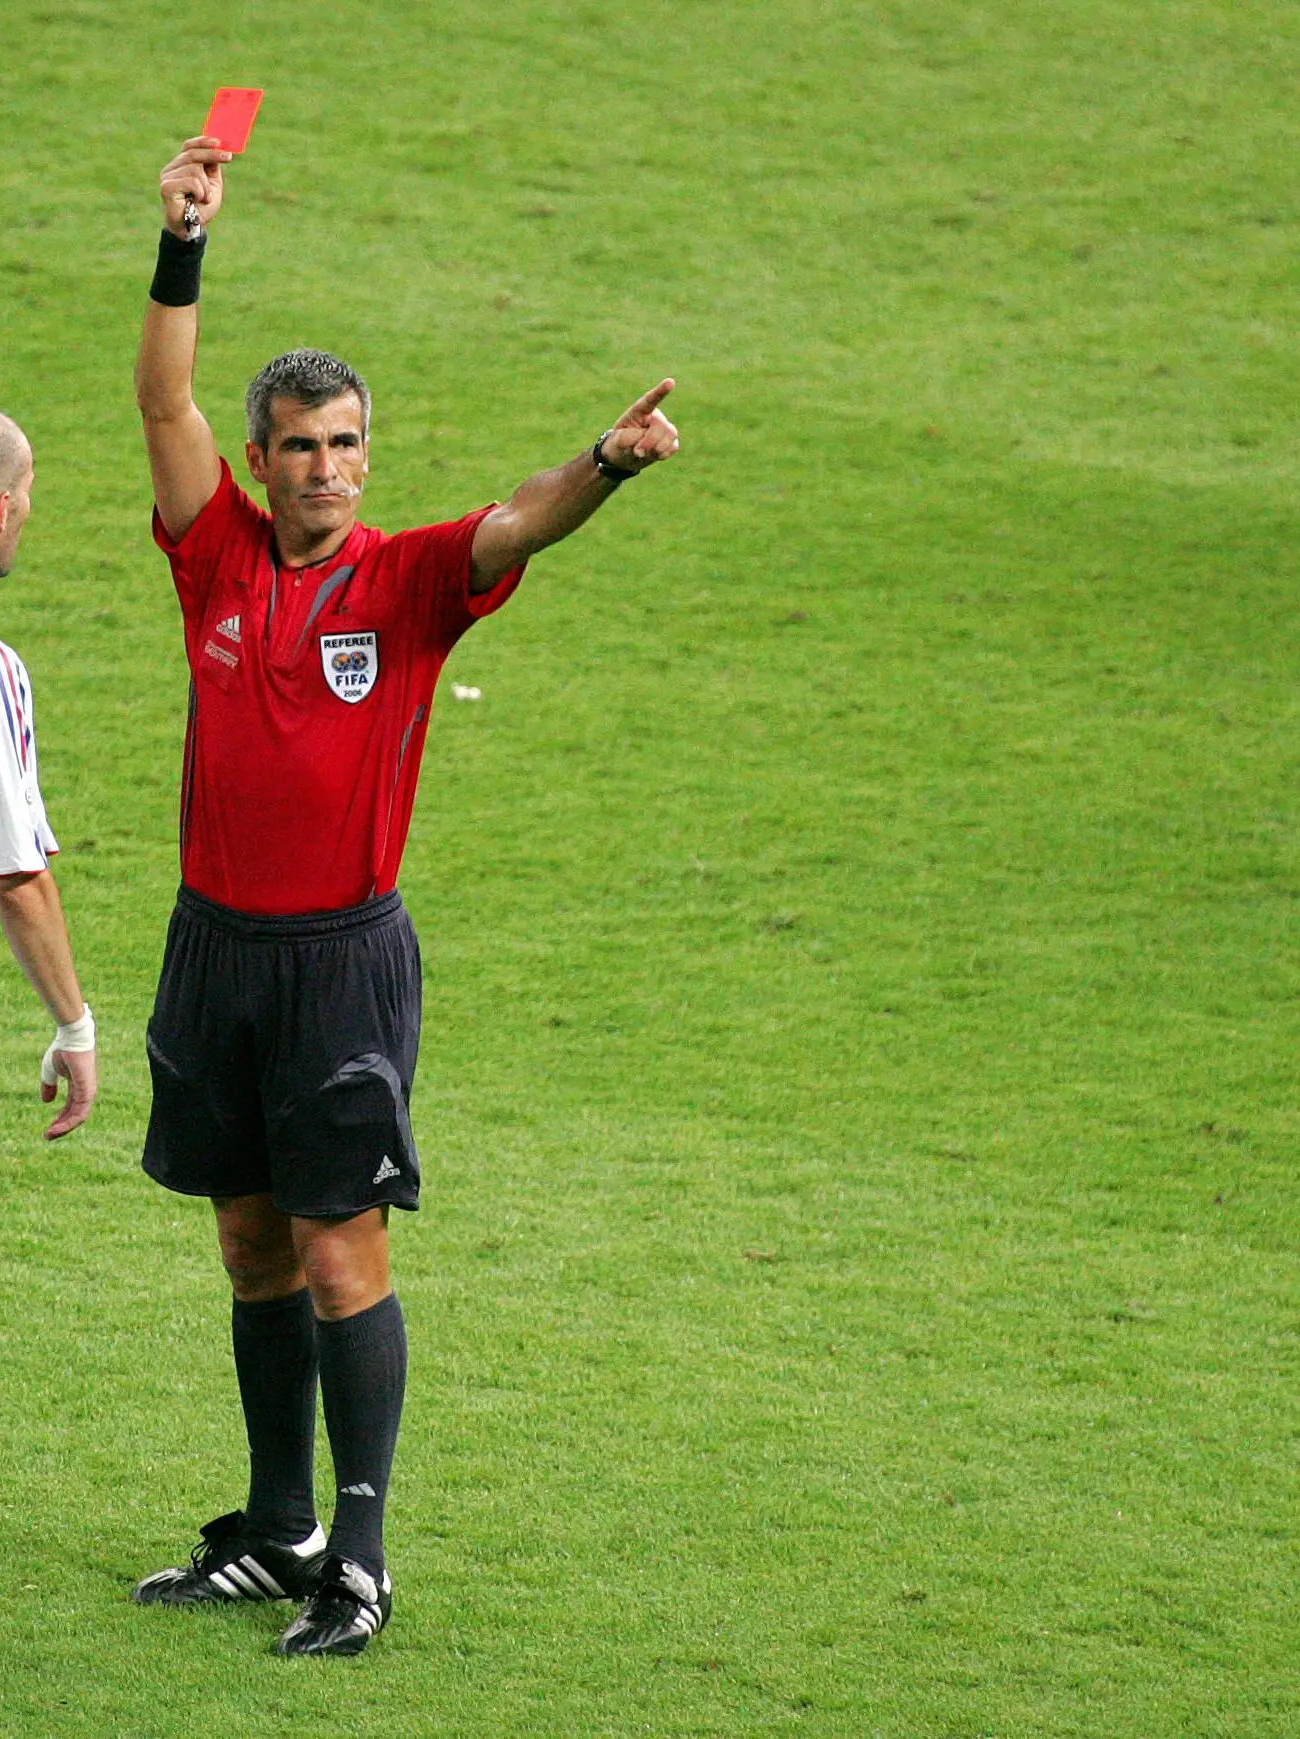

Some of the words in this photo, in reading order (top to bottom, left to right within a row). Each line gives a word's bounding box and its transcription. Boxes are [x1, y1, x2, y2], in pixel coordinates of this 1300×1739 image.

[323, 635, 374, 649] REFEREE
[335, 673, 369, 687] FIFA
[342, 688, 363, 698] 2006
